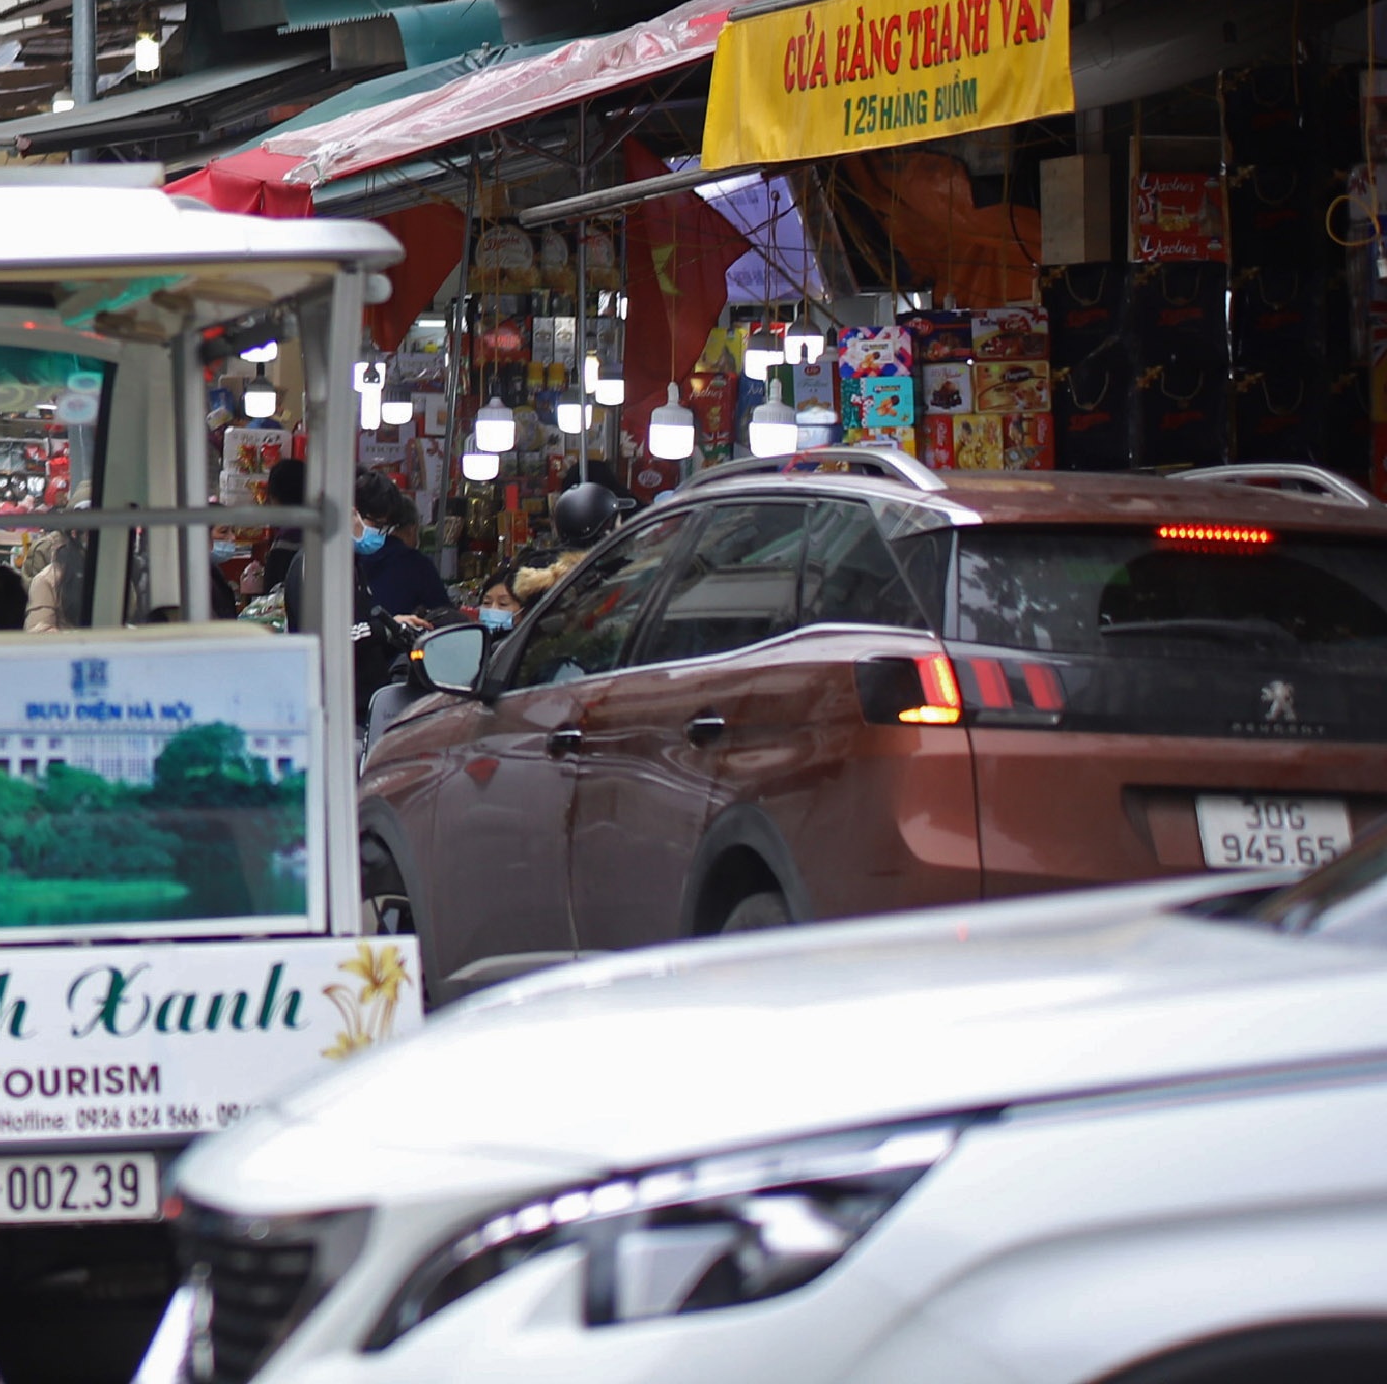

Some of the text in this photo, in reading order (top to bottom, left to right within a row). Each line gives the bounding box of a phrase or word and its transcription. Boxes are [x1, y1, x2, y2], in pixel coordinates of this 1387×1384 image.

[835, 6, 902, 86] HÀNG
[1221, 833, 1337, 865] 945.65
[69, 961, 310, 1040] Xanh
